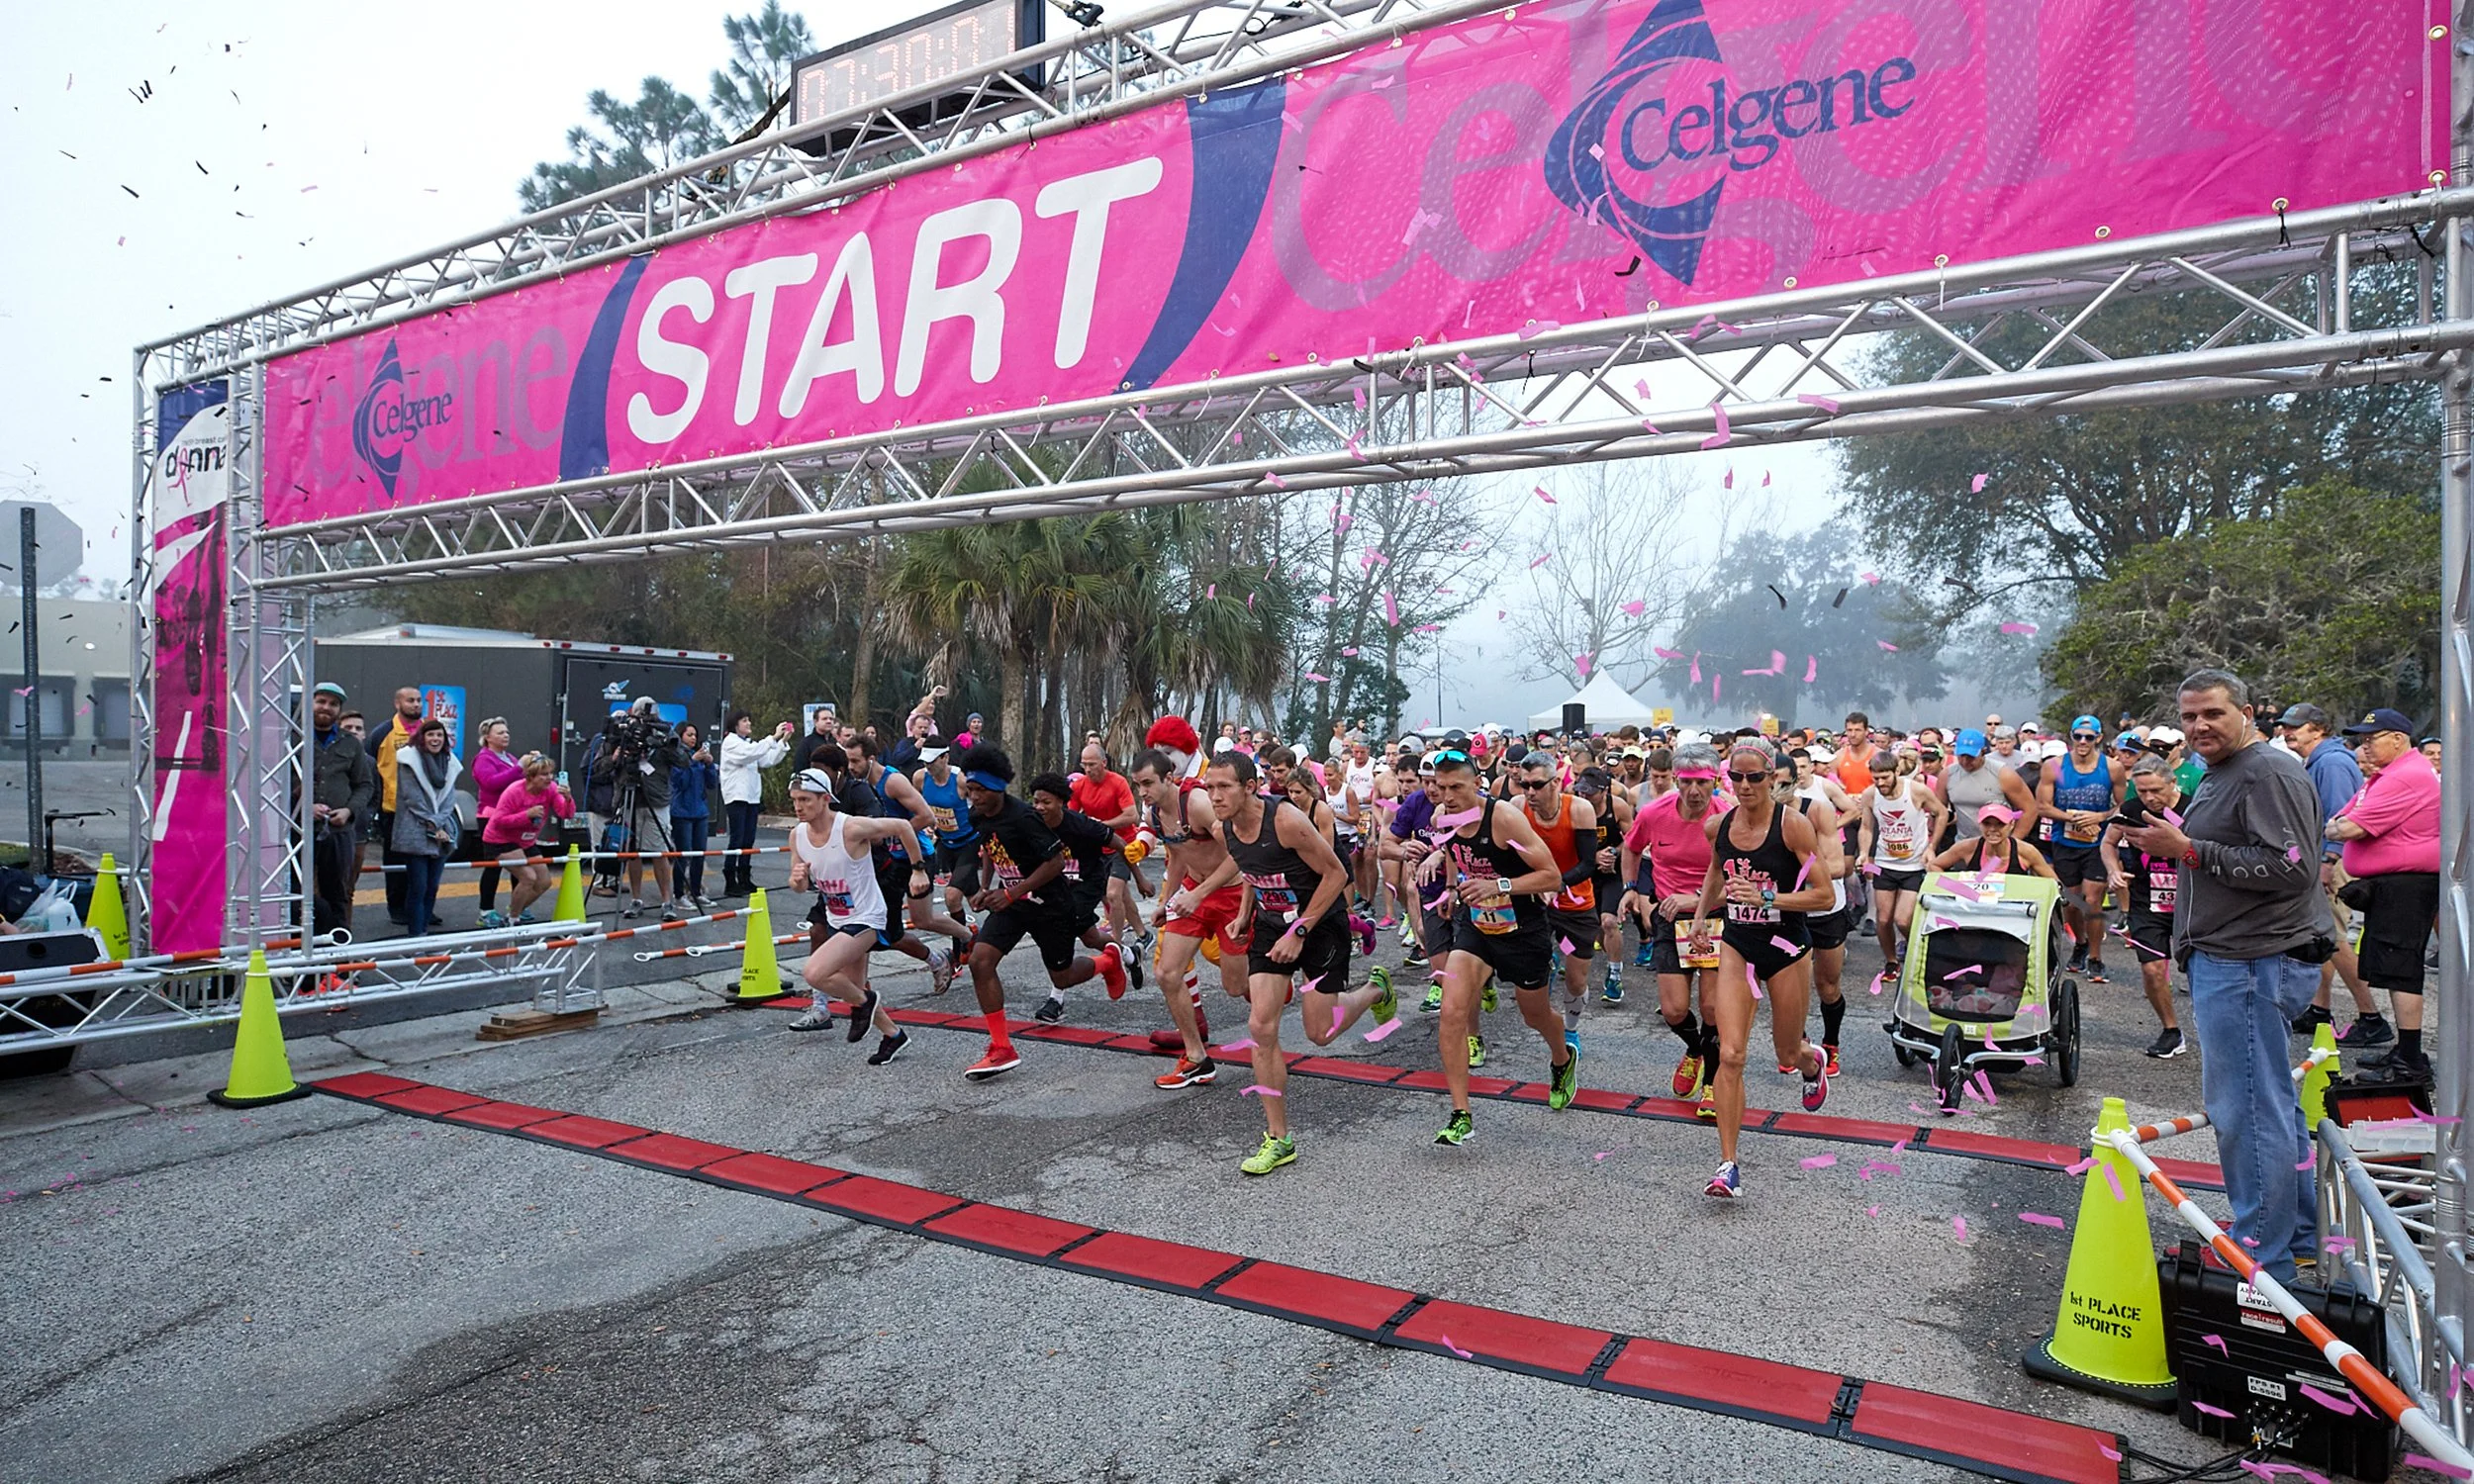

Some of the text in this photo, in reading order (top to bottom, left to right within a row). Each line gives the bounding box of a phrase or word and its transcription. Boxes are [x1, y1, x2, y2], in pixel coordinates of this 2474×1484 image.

[1621, 57, 1916, 172] Celgene
[627, 156, 1164, 444] START
[373, 392, 452, 442] Celgene
[1259, 890, 1289, 901] 1298
[1483, 911, 1496, 923] 11
[1734, 905, 1769, 921] 1474
[1688, 942, 1715, 956] 26
[2070, 1291, 2141, 1322] 1st PLACE
[2073, 1312, 2133, 1339] SPORTS
